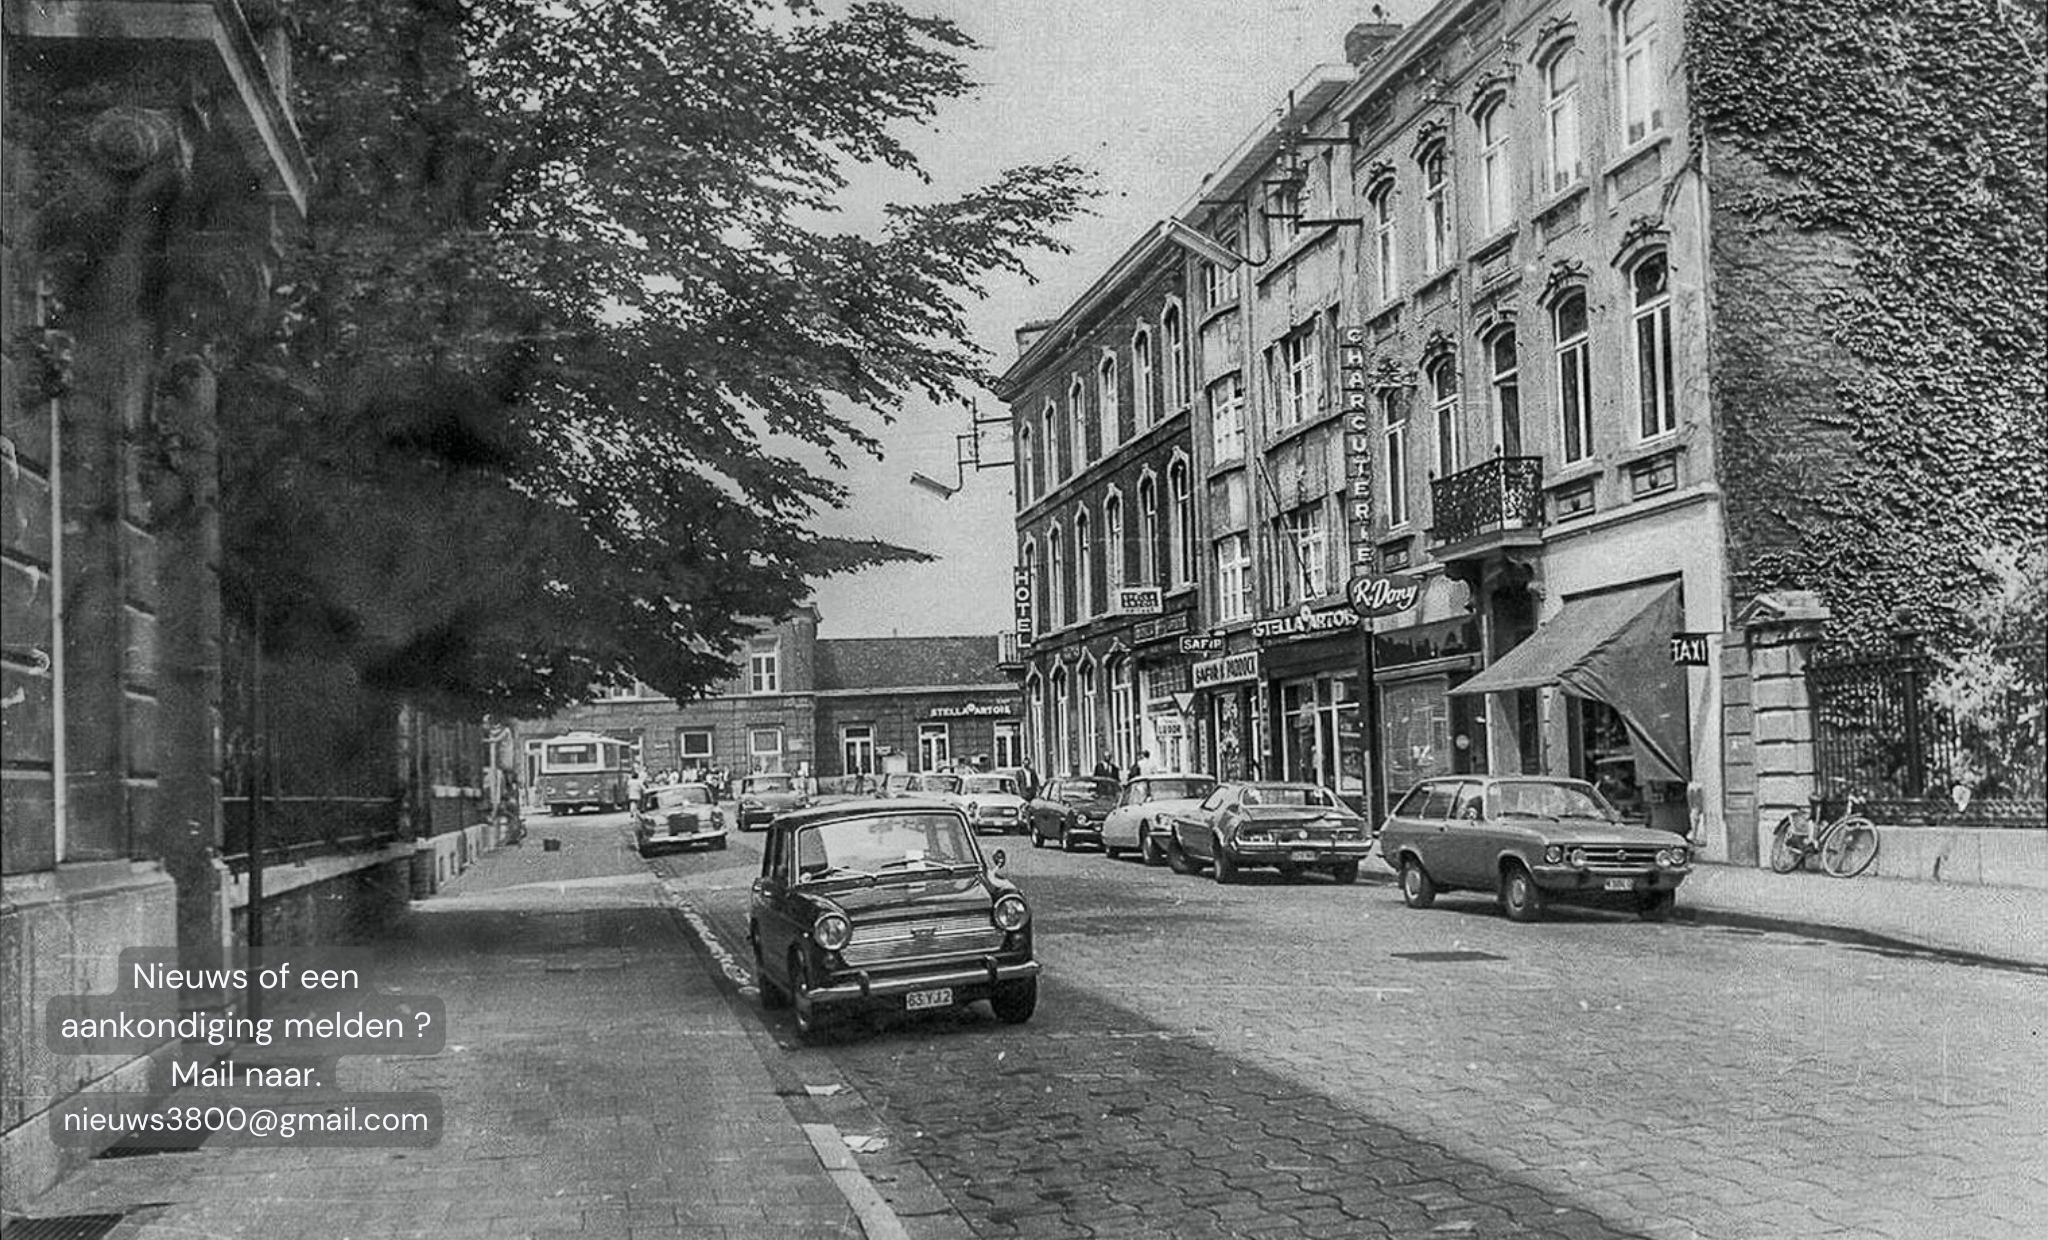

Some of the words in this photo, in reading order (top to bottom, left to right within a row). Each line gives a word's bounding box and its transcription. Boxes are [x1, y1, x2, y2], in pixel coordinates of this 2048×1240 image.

[1348, 327, 1373, 562] CHARCUTERIE
[1015, 570, 1031, 648] HOTEL
[1252, 615, 1304, 637] STELLA
[1309, 607, 1360, 631] ARTOIS
[1671, 639, 1706, 662] TAXI
[930, 707, 970, 718] STELLA
[973, 704, 1012, 716] ARTOIS
